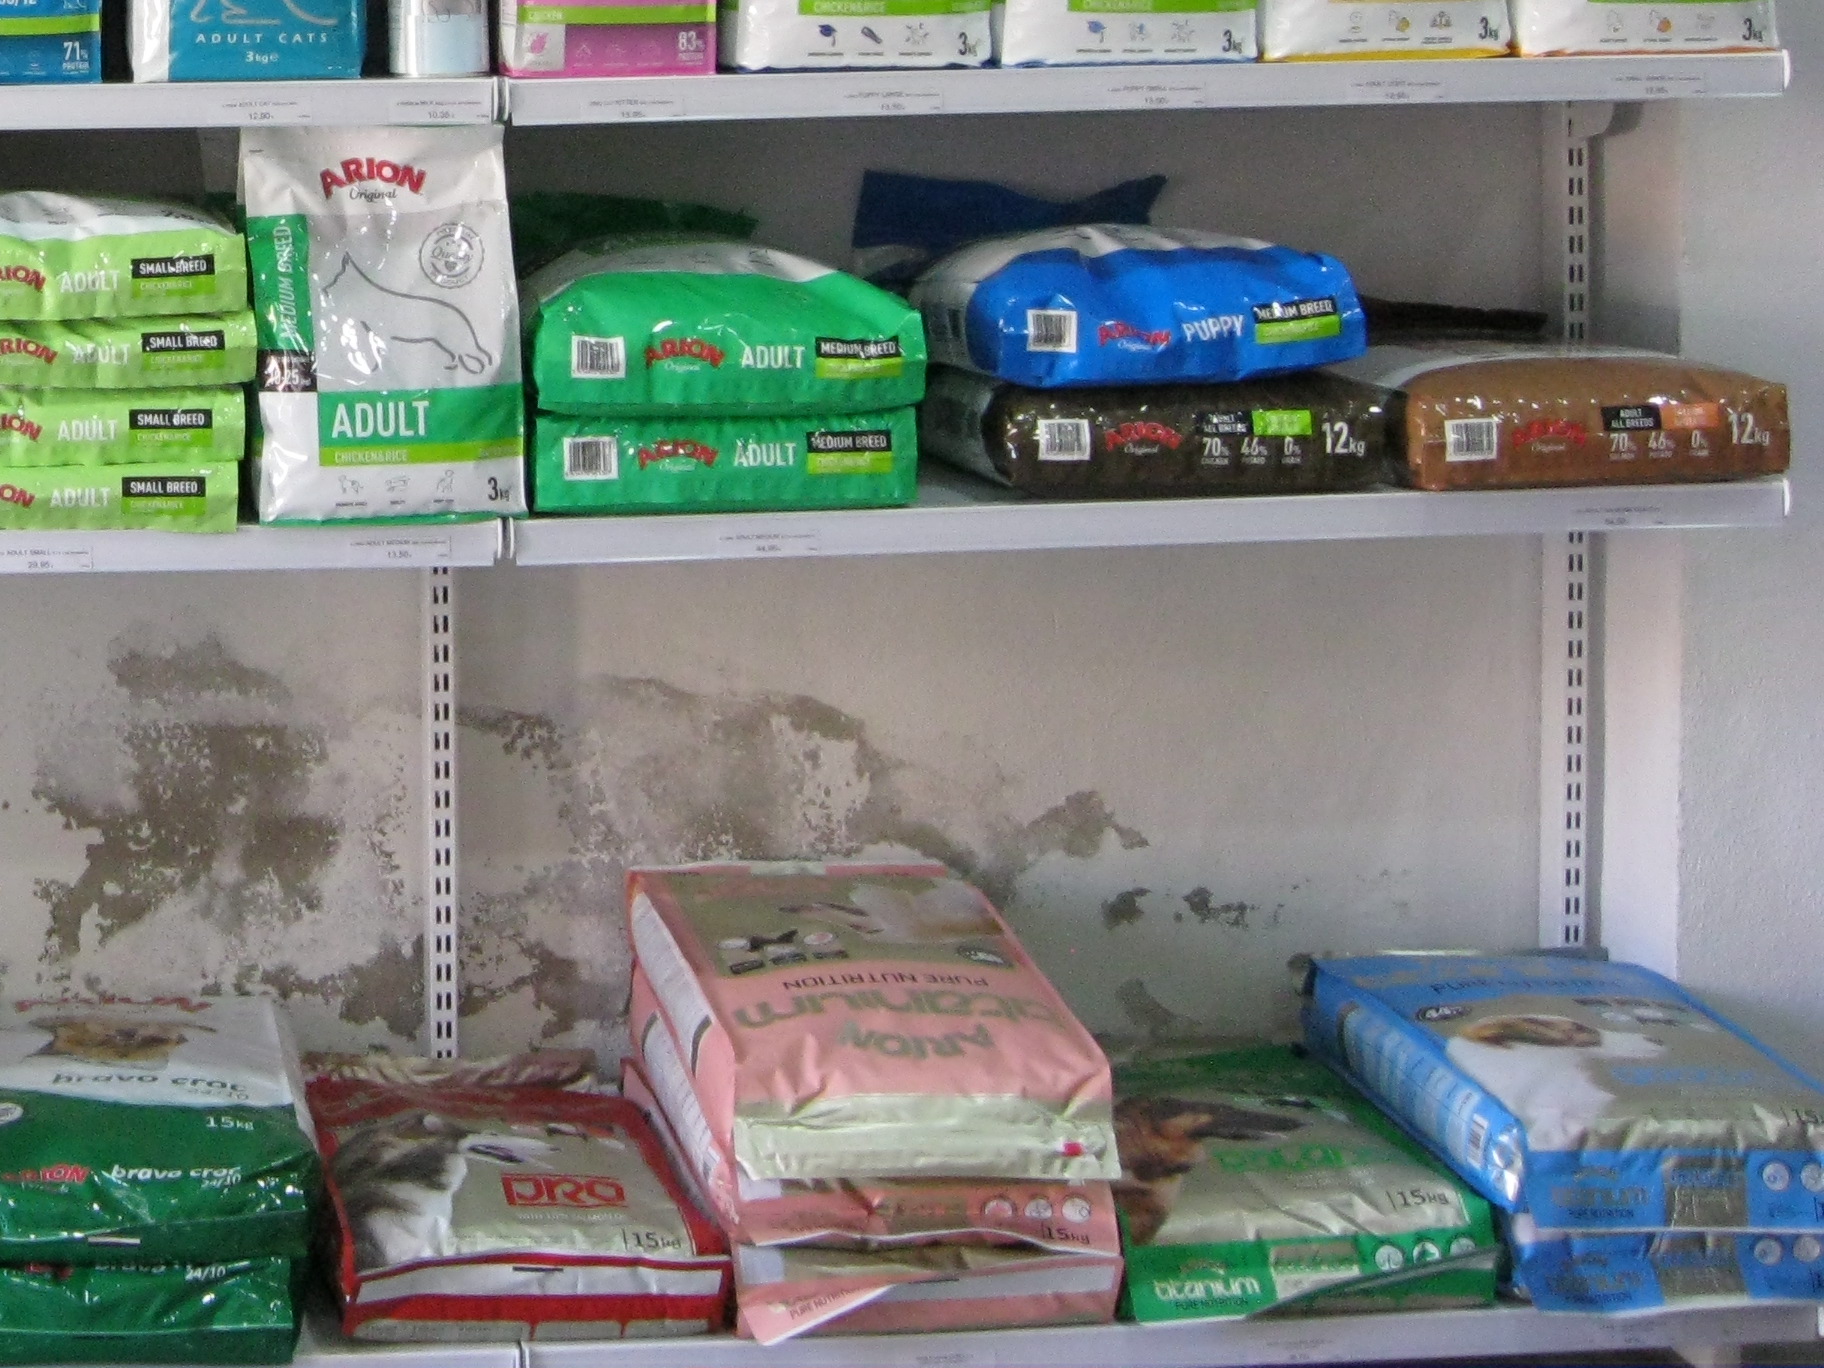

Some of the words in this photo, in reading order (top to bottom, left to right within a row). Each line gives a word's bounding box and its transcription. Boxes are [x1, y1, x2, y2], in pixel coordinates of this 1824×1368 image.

[195, 33, 264, 44] ADULT
[278, 32, 329, 44] CATS
[1477, 16, 1501, 41] 3kg
[319, 157, 428, 197] ARION
[349, 187, 398, 203] Original
[138, 261, 171, 274] SMALL
[174, 259, 207, 273] BREED
[1182, 313, 1245, 343] PUPPY
[1299, 298, 1334, 317] BREED
[73, 343, 131, 365] ADULT
[149, 336, 184, 349] SMALL
[186, 335, 218, 348] BREED
[644, 337, 725, 368] ARION
[741, 346, 806, 370] ADULT
[820, 341, 863, 355] MEDIUM
[864, 340, 897, 356] BREED
[58, 420, 118, 441] ADULT
[137, 414, 170, 426] SMALL
[172, 413, 205, 426] BREED
[331, 400, 430, 439] ADULT
[1729, 413, 1771, 446] 12kg
[1105, 420, 1183, 452] ARION
[1322, 421, 1366, 458] 12kg
[637, 439, 719, 470] ARION
[734, 443, 797, 468] ADULT
[810, 435, 855, 450] MEDIUM
[856, 434, 888, 449] BREED
[50, 488, 110, 508] ADULT
[129, 482, 164, 494] SMALL
[166, 481, 198, 494] BREED
[782, 971, 921, 991] NUTRITION
[924, 974, 989, 987] PURE
[112, 1164, 183, 1180] bravo
[1153, 1276, 1261, 1301] titanium
